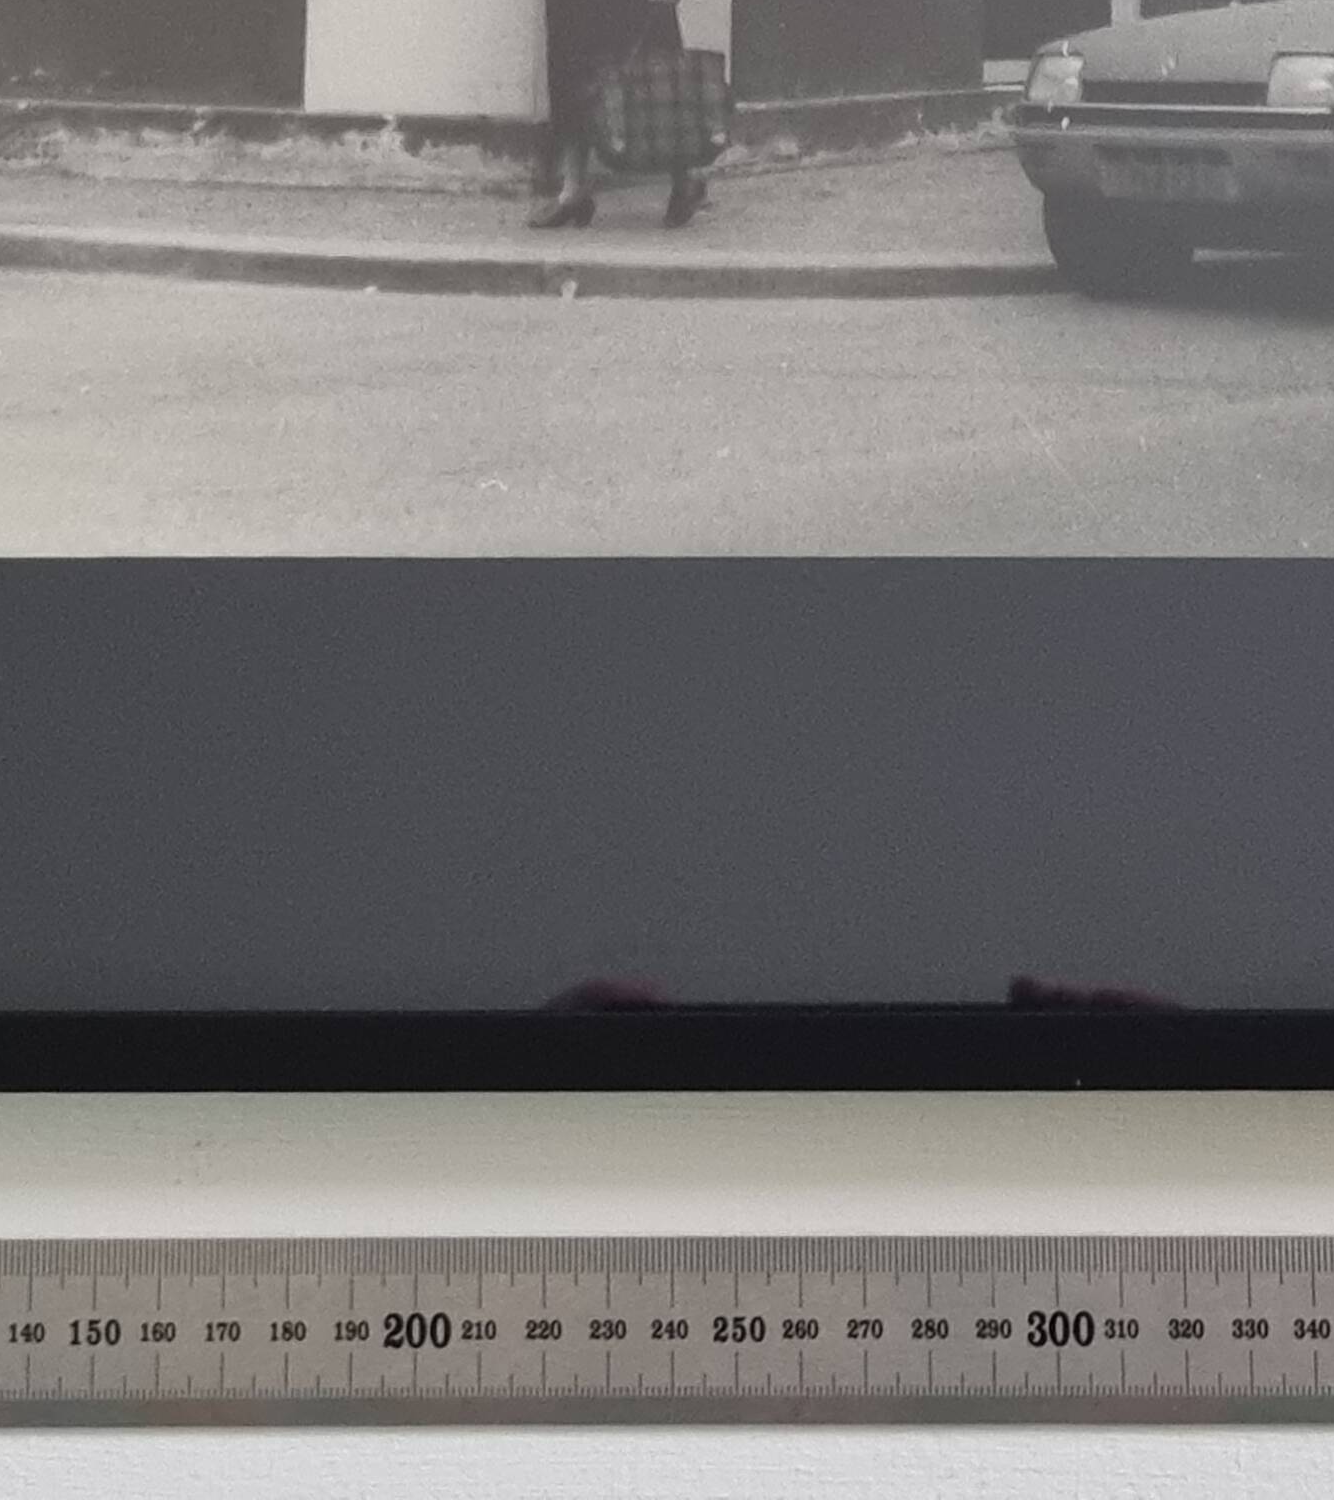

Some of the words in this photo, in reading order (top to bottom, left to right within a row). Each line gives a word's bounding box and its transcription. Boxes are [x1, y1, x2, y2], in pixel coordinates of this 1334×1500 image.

[8, 1322, 46, 1344] 140
[69, 1318, 122, 1346] 150
[140, 1321, 177, 1343] 160
[205, 1321, 241, 1343] 170
[270, 1320, 307, 1342] 180
[334, 1320, 370, 1342] 190
[382, 1314, 452, 1350] 200
[461, 1319, 497, 1341] 210
[524, 1319, 563, 1341] 220
[588, 1319, 627, 1341] 230
[650, 1318, 689, 1340] 240
[712, 1315, 767, 1344] 250
[782, 1318, 820, 1340] 260
[846, 1318, 884, 1340] 270
[911, 1318, 949, 1340] 280
[975, 1318, 1013, 1340] 290
[1027, 1313, 1096, 1348] 300
[1104, 1318, 1140, 1340] 310
[1168, 1318, 1205, 1341] 320
[1232, 1318, 1270, 1340] 330
[1293, 1318, 1331, 1340] 340
